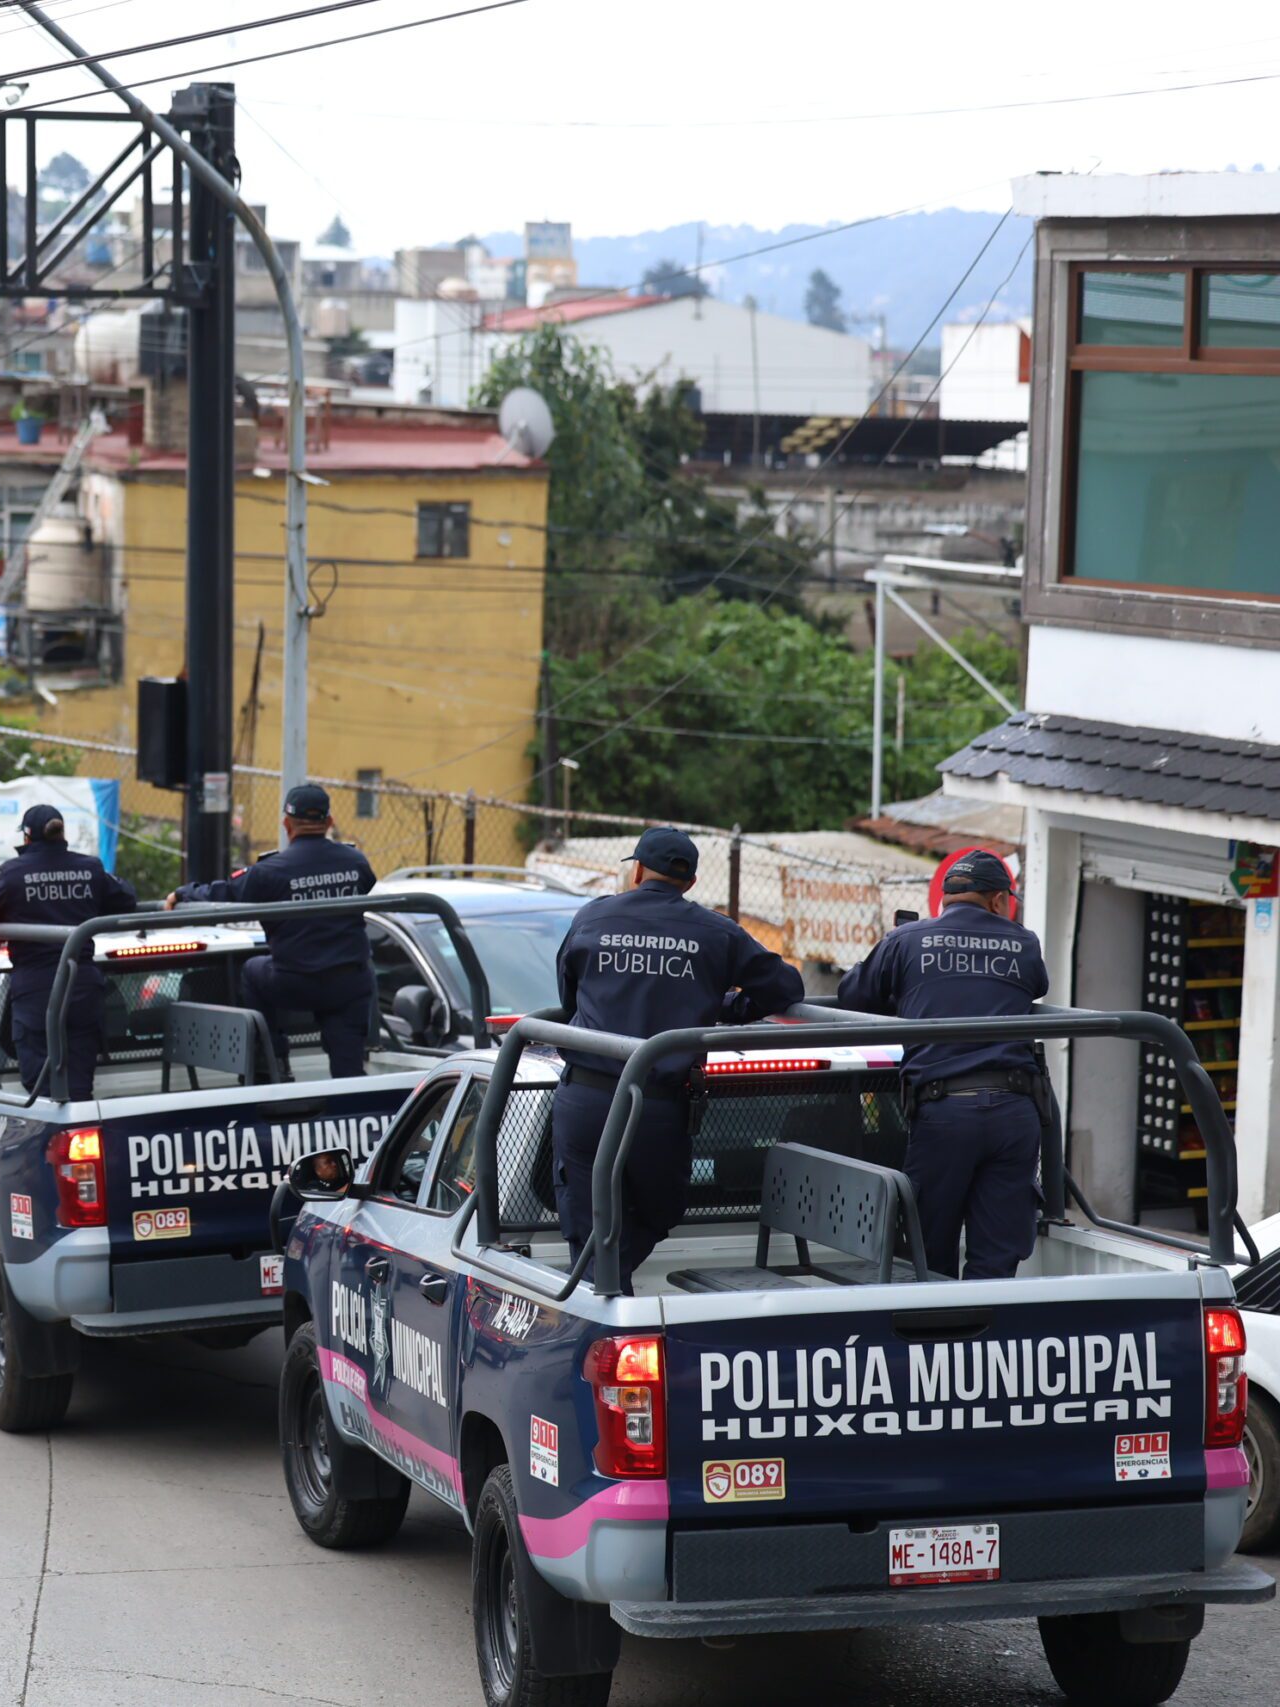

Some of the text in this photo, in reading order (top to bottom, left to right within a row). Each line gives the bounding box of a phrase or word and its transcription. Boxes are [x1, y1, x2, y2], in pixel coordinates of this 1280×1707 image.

[23, 870, 93, 885] SEGURIDAD
[289, 870, 360, 890] SEGURIDAD
[24, 883, 94, 902] PÚBLICA
[599, 934, 700, 953] SEGURIDAD
[921, 935, 1023, 953] SEGURIDAD
[598, 949, 696, 981] PÚBLICA
[920, 949, 1021, 979] PÚBLICA
[127, 1120, 264, 1178] POLICÍA
[12, 1197, 31, 1215] 911
[155, 1210, 187, 1229] 089
[263, 1265, 283, 1285] ME
[490, 1291, 540, 1341] ME-148A-7
[331, 1280, 368, 1356] POLICÍA
[391, 1317, 447, 1408] MUNICIPAL
[700, 1331, 1172, 1412] POLICÍA MUNICIPAL
[701, 1395, 1172, 1442] HUIXQUILUCAN
[532, 1422, 555, 1448] 911
[1120, 1436, 1163, 1453] 911
[531, 1450, 558, 1468] EMERGENCIAS
[1116, 1458, 1169, 1468] EMERGENCIAS
[735, 1463, 779, 1487] 089
[891, 1540, 997, 1570] ME-148A-7
